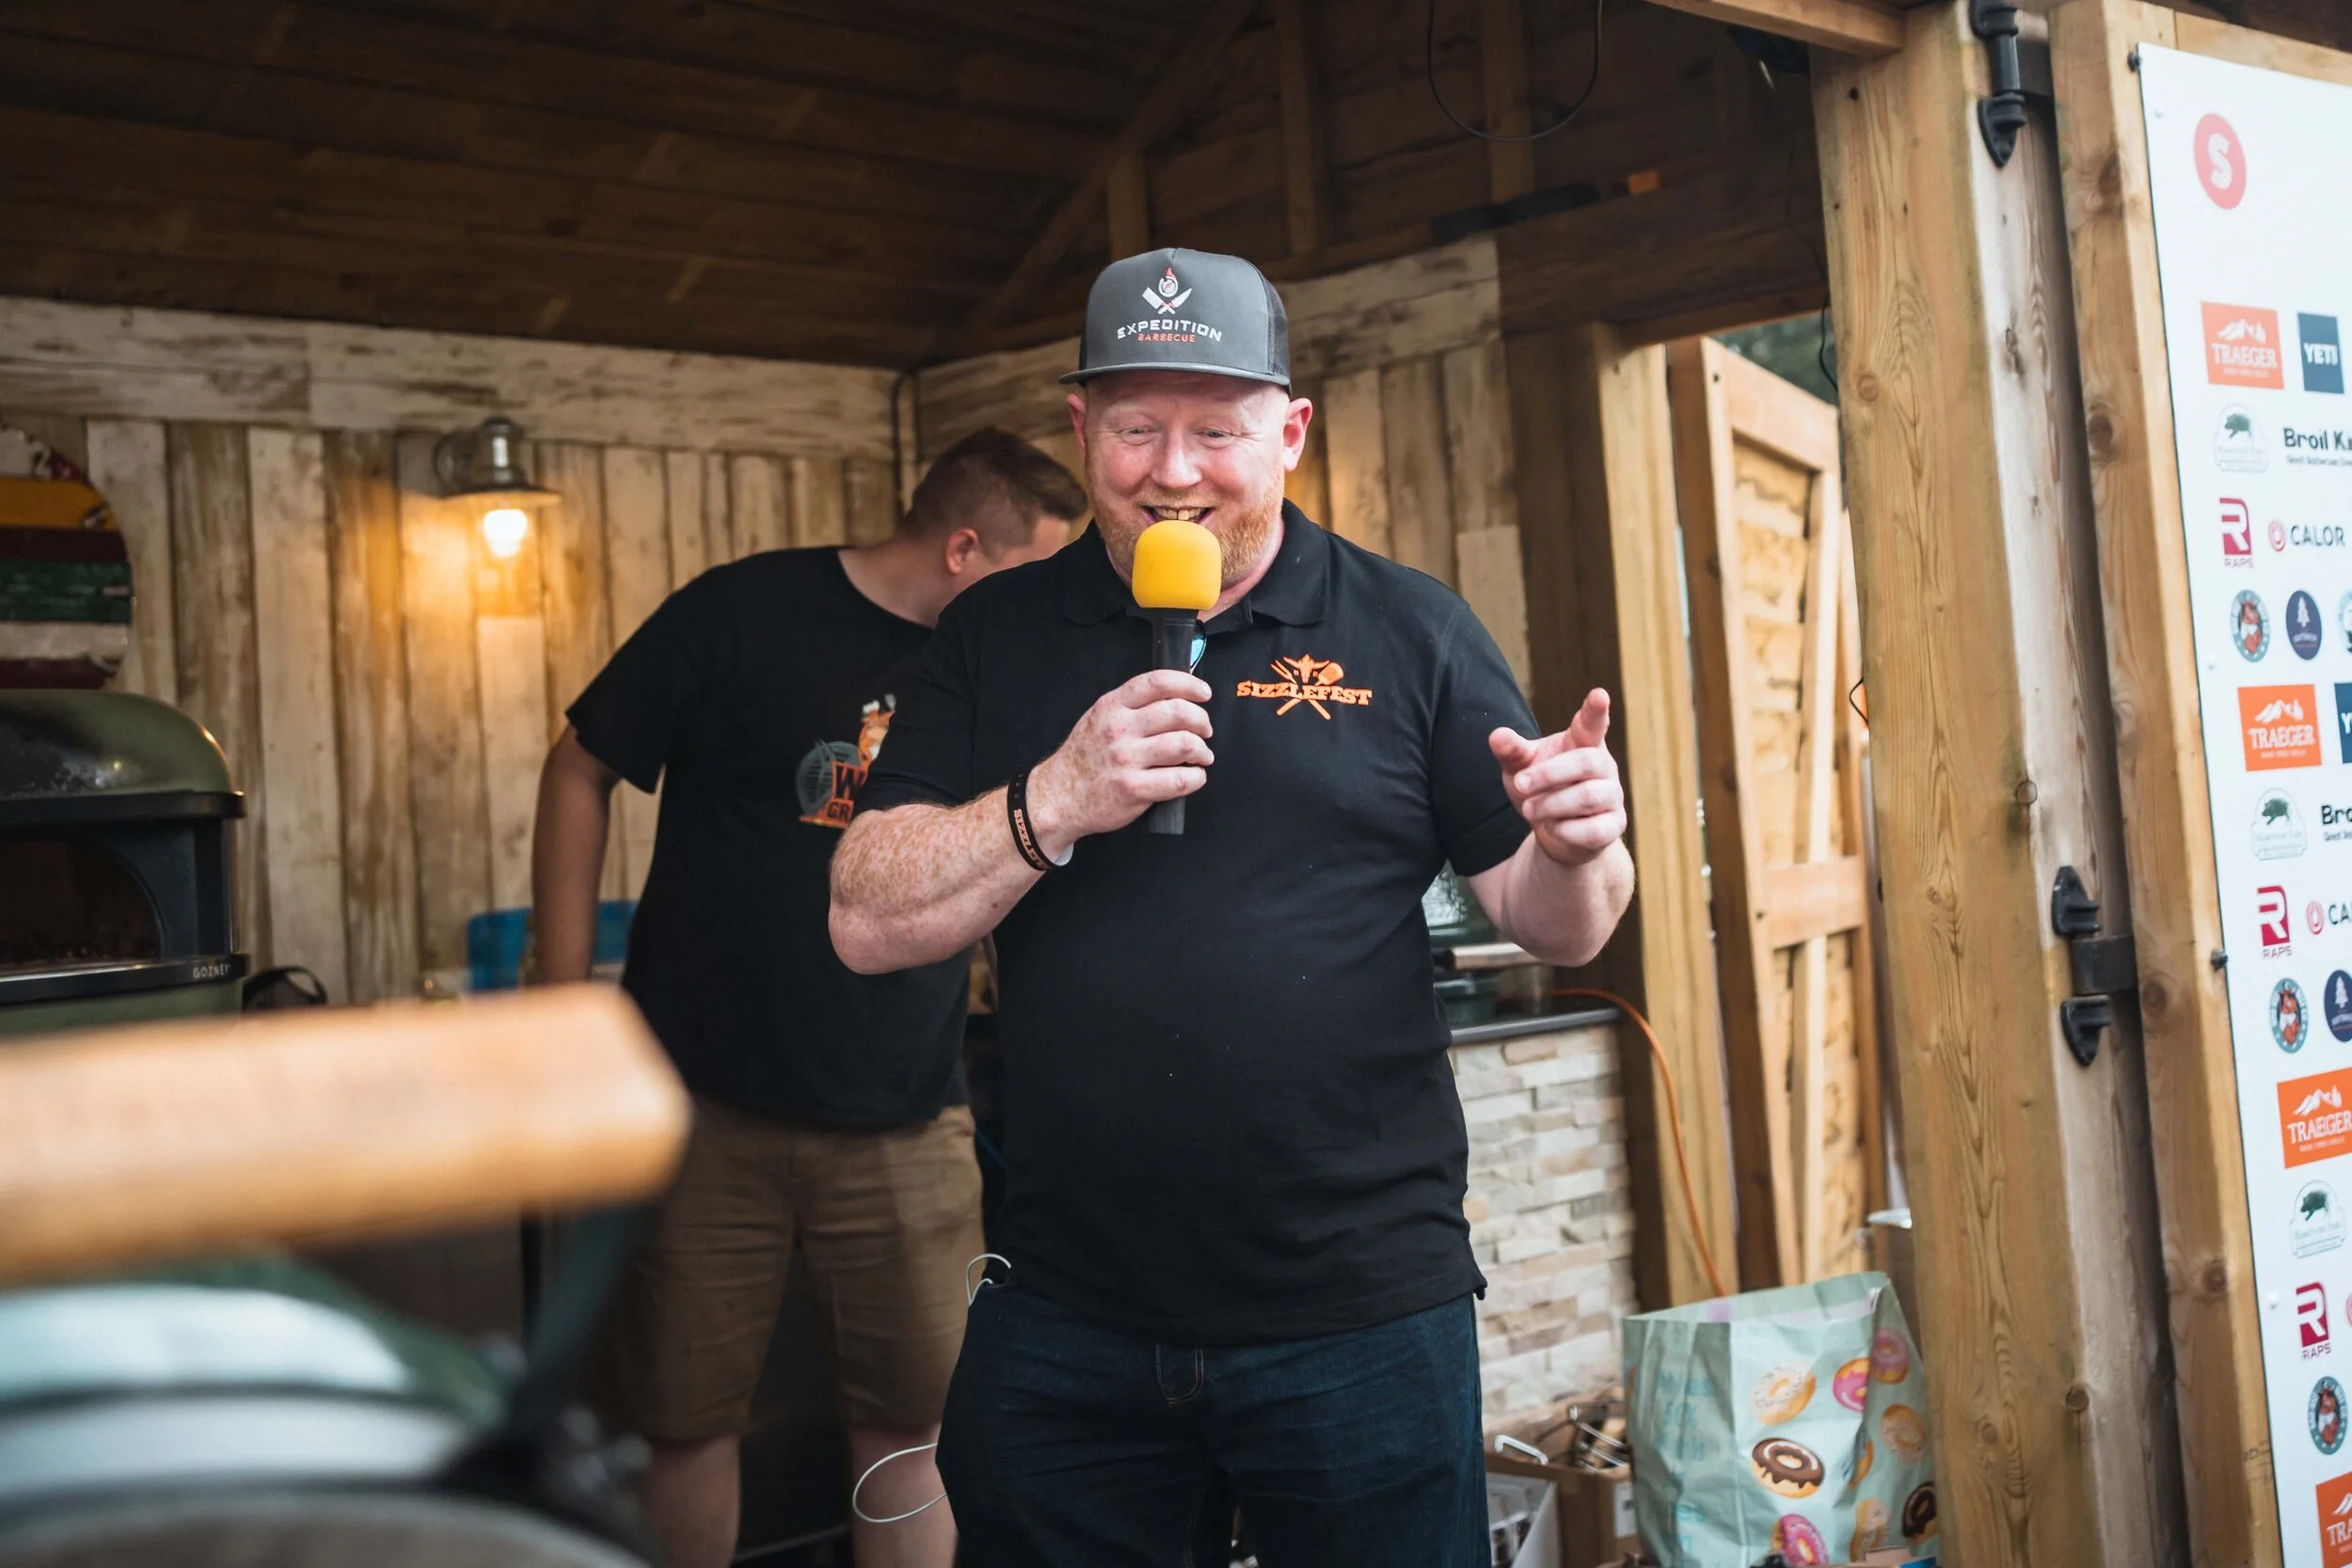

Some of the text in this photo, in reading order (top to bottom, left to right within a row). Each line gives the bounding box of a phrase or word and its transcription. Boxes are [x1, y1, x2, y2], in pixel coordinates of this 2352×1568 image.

[1117, 319, 1223, 342] EXPEDITION
[1137, 332, 1197, 342] BARBECUE
[2211, 341, 2278, 370] TRAEGER
[2303, 342, 2339, 366] YETI
[2283, 427, 2328, 451] Broil
[2290, 524, 2345, 546] CALOR
[1236, 680, 1373, 705] SIZZLEFEST
[2248, 724, 2315, 750] TRAEGER
[2287, 1110, 2352, 1144] TRAEGER
[2302, 1342, 2332, 1360] RAPS
